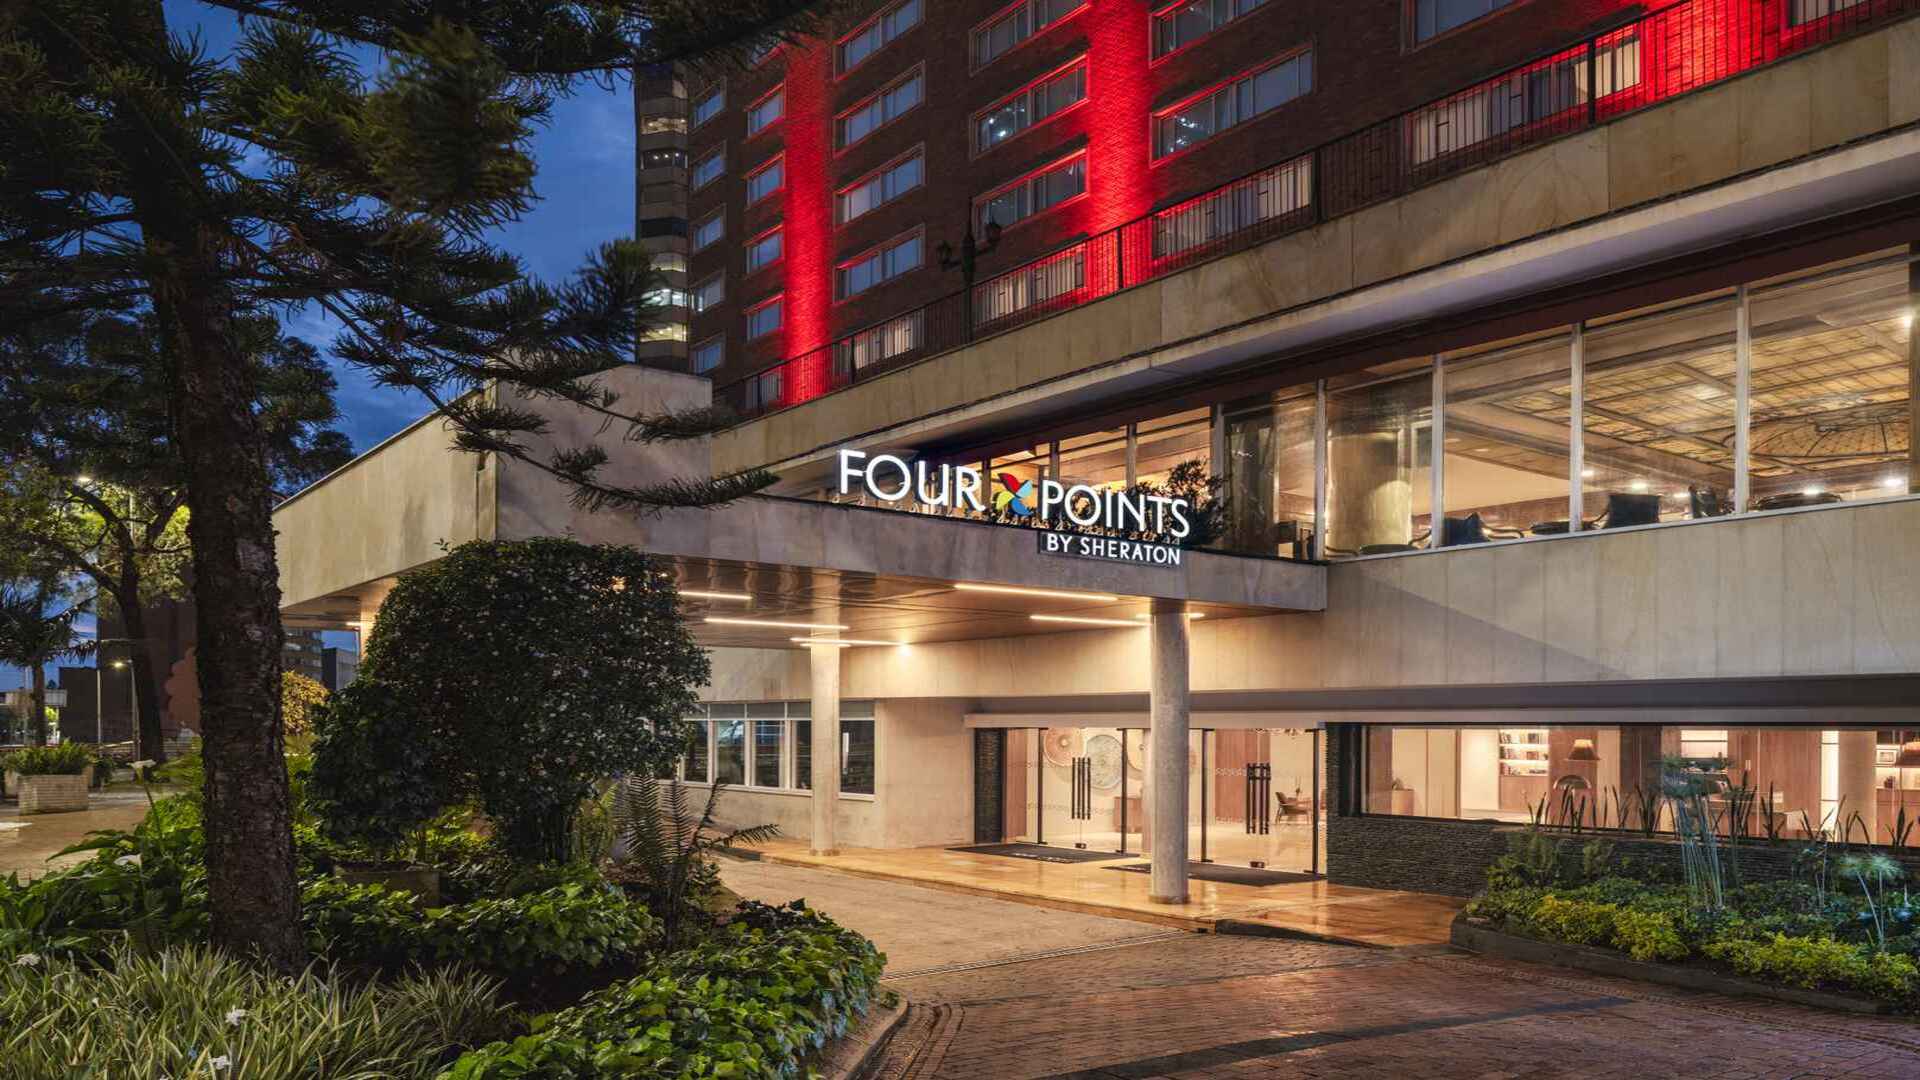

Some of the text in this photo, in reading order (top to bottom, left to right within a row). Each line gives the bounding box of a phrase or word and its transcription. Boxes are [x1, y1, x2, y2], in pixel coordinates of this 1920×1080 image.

[839, 449, 1190, 538] FOUR POINTS
[1047, 533, 1181, 565] BY SHERATON
